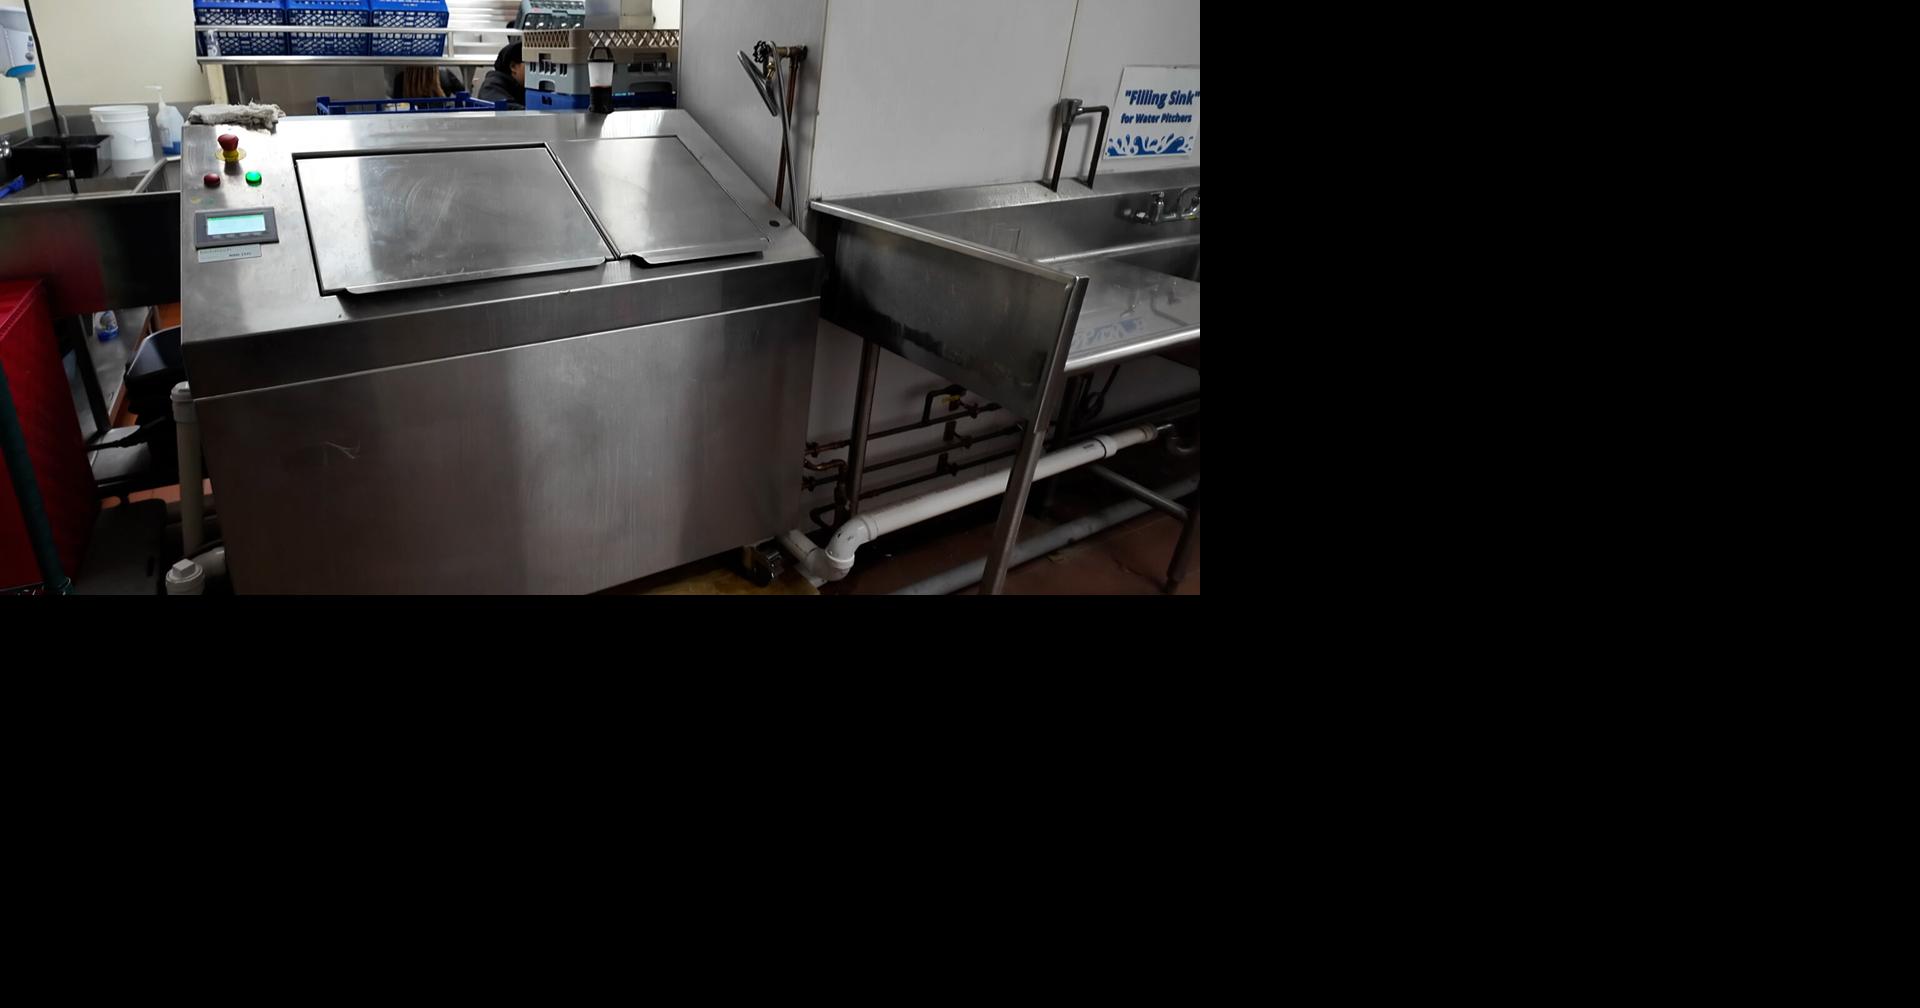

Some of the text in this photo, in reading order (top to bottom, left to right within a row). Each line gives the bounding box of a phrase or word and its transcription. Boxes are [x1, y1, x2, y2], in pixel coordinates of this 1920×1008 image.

[1125, 89, 1168, 109] "Filling
[1120, 112, 1192, 123] for Water Pitchers
